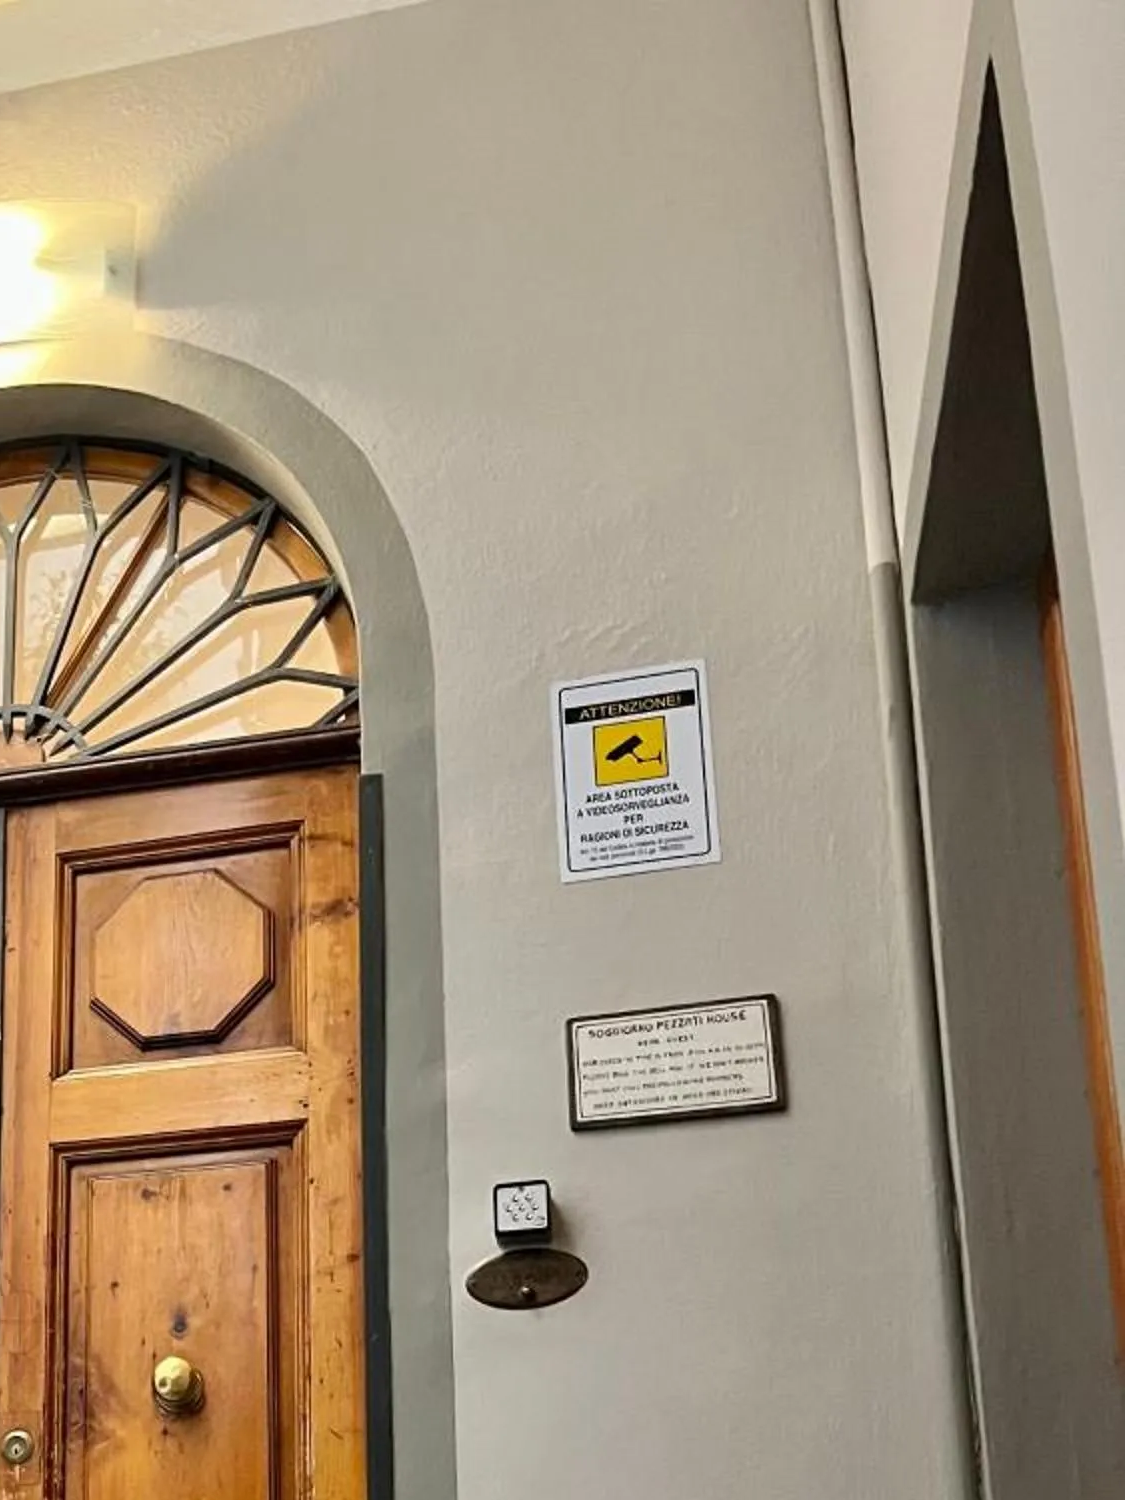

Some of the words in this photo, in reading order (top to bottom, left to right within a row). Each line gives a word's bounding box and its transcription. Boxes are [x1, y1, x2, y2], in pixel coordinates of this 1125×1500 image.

[580, 695, 681, 719] ATTENZIONE!
[586, 792, 612, 804] AREA
[615, 782, 680, 799] SOTTOPOSTA
[577, 808, 584, 818] A
[585, 794, 690, 816] VIDEOSORVEGLIANZA
[624, 814, 644, 824] PER
[581, 829, 620, 843] RAGIONI
[623, 828, 632, 838] DI
[634, 821, 690, 836] SICUREZZA
[706, 1010, 747, 1024] HOUSE
